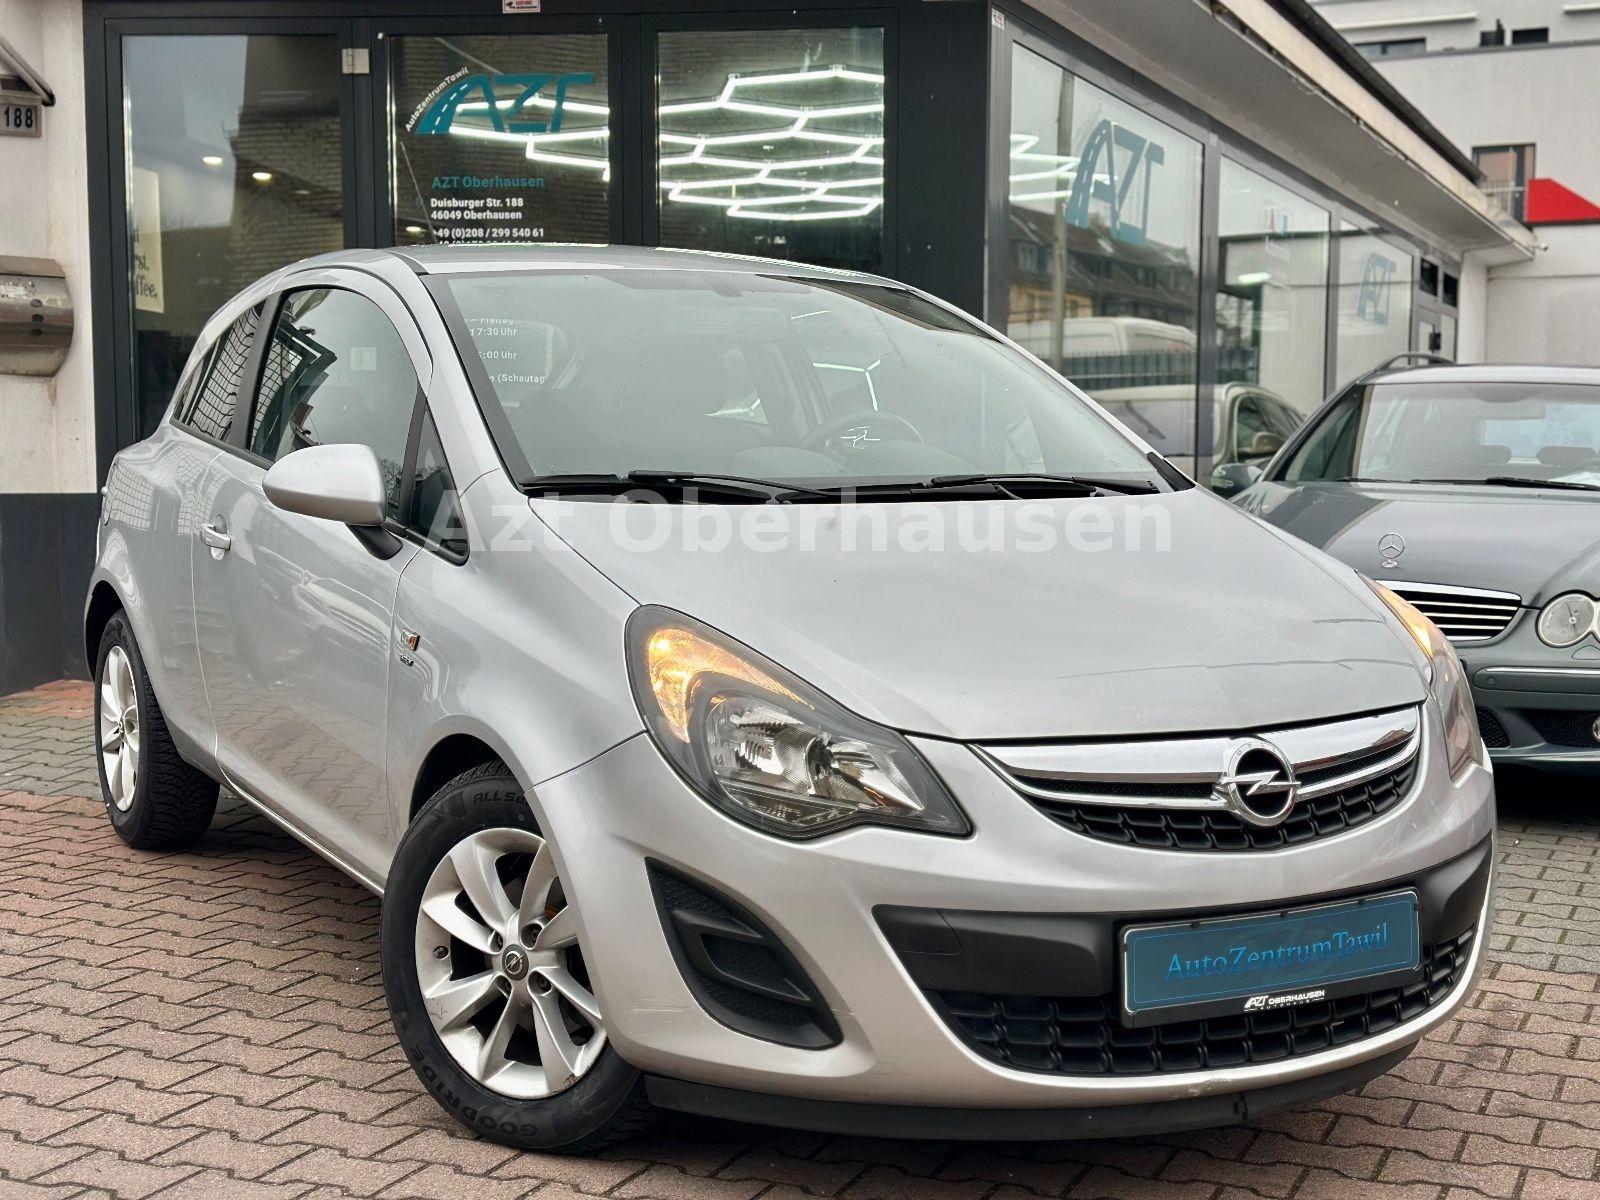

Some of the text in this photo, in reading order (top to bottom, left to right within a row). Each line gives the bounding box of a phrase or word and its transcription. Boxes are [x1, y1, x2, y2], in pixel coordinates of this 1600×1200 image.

[414, 72, 594, 136] AZT
[4, 105, 34, 128] 188
[431, 176, 545, 189] AZT Oberhausen
[1065, 118, 1165, 246] AZT
[430, 198, 524, 209] Duisburger Str. 188
[430, 209, 523, 220] 46049 Oberhausen
[451, 227, 484, 239] (0)208
[491, 228, 511, 238] 299
[512, 228, 531, 238] 540
[532, 228, 545, 238] 61
[500, 327, 518, 337] Uhr
[501, 350, 517, 359] Uhr
[1163, 922, 1388, 982] AutoZentrumTawil
[1268, 989, 1326, 1005] OBERHAUSEN
[410, 1045, 538, 1137] GOODRIDE
